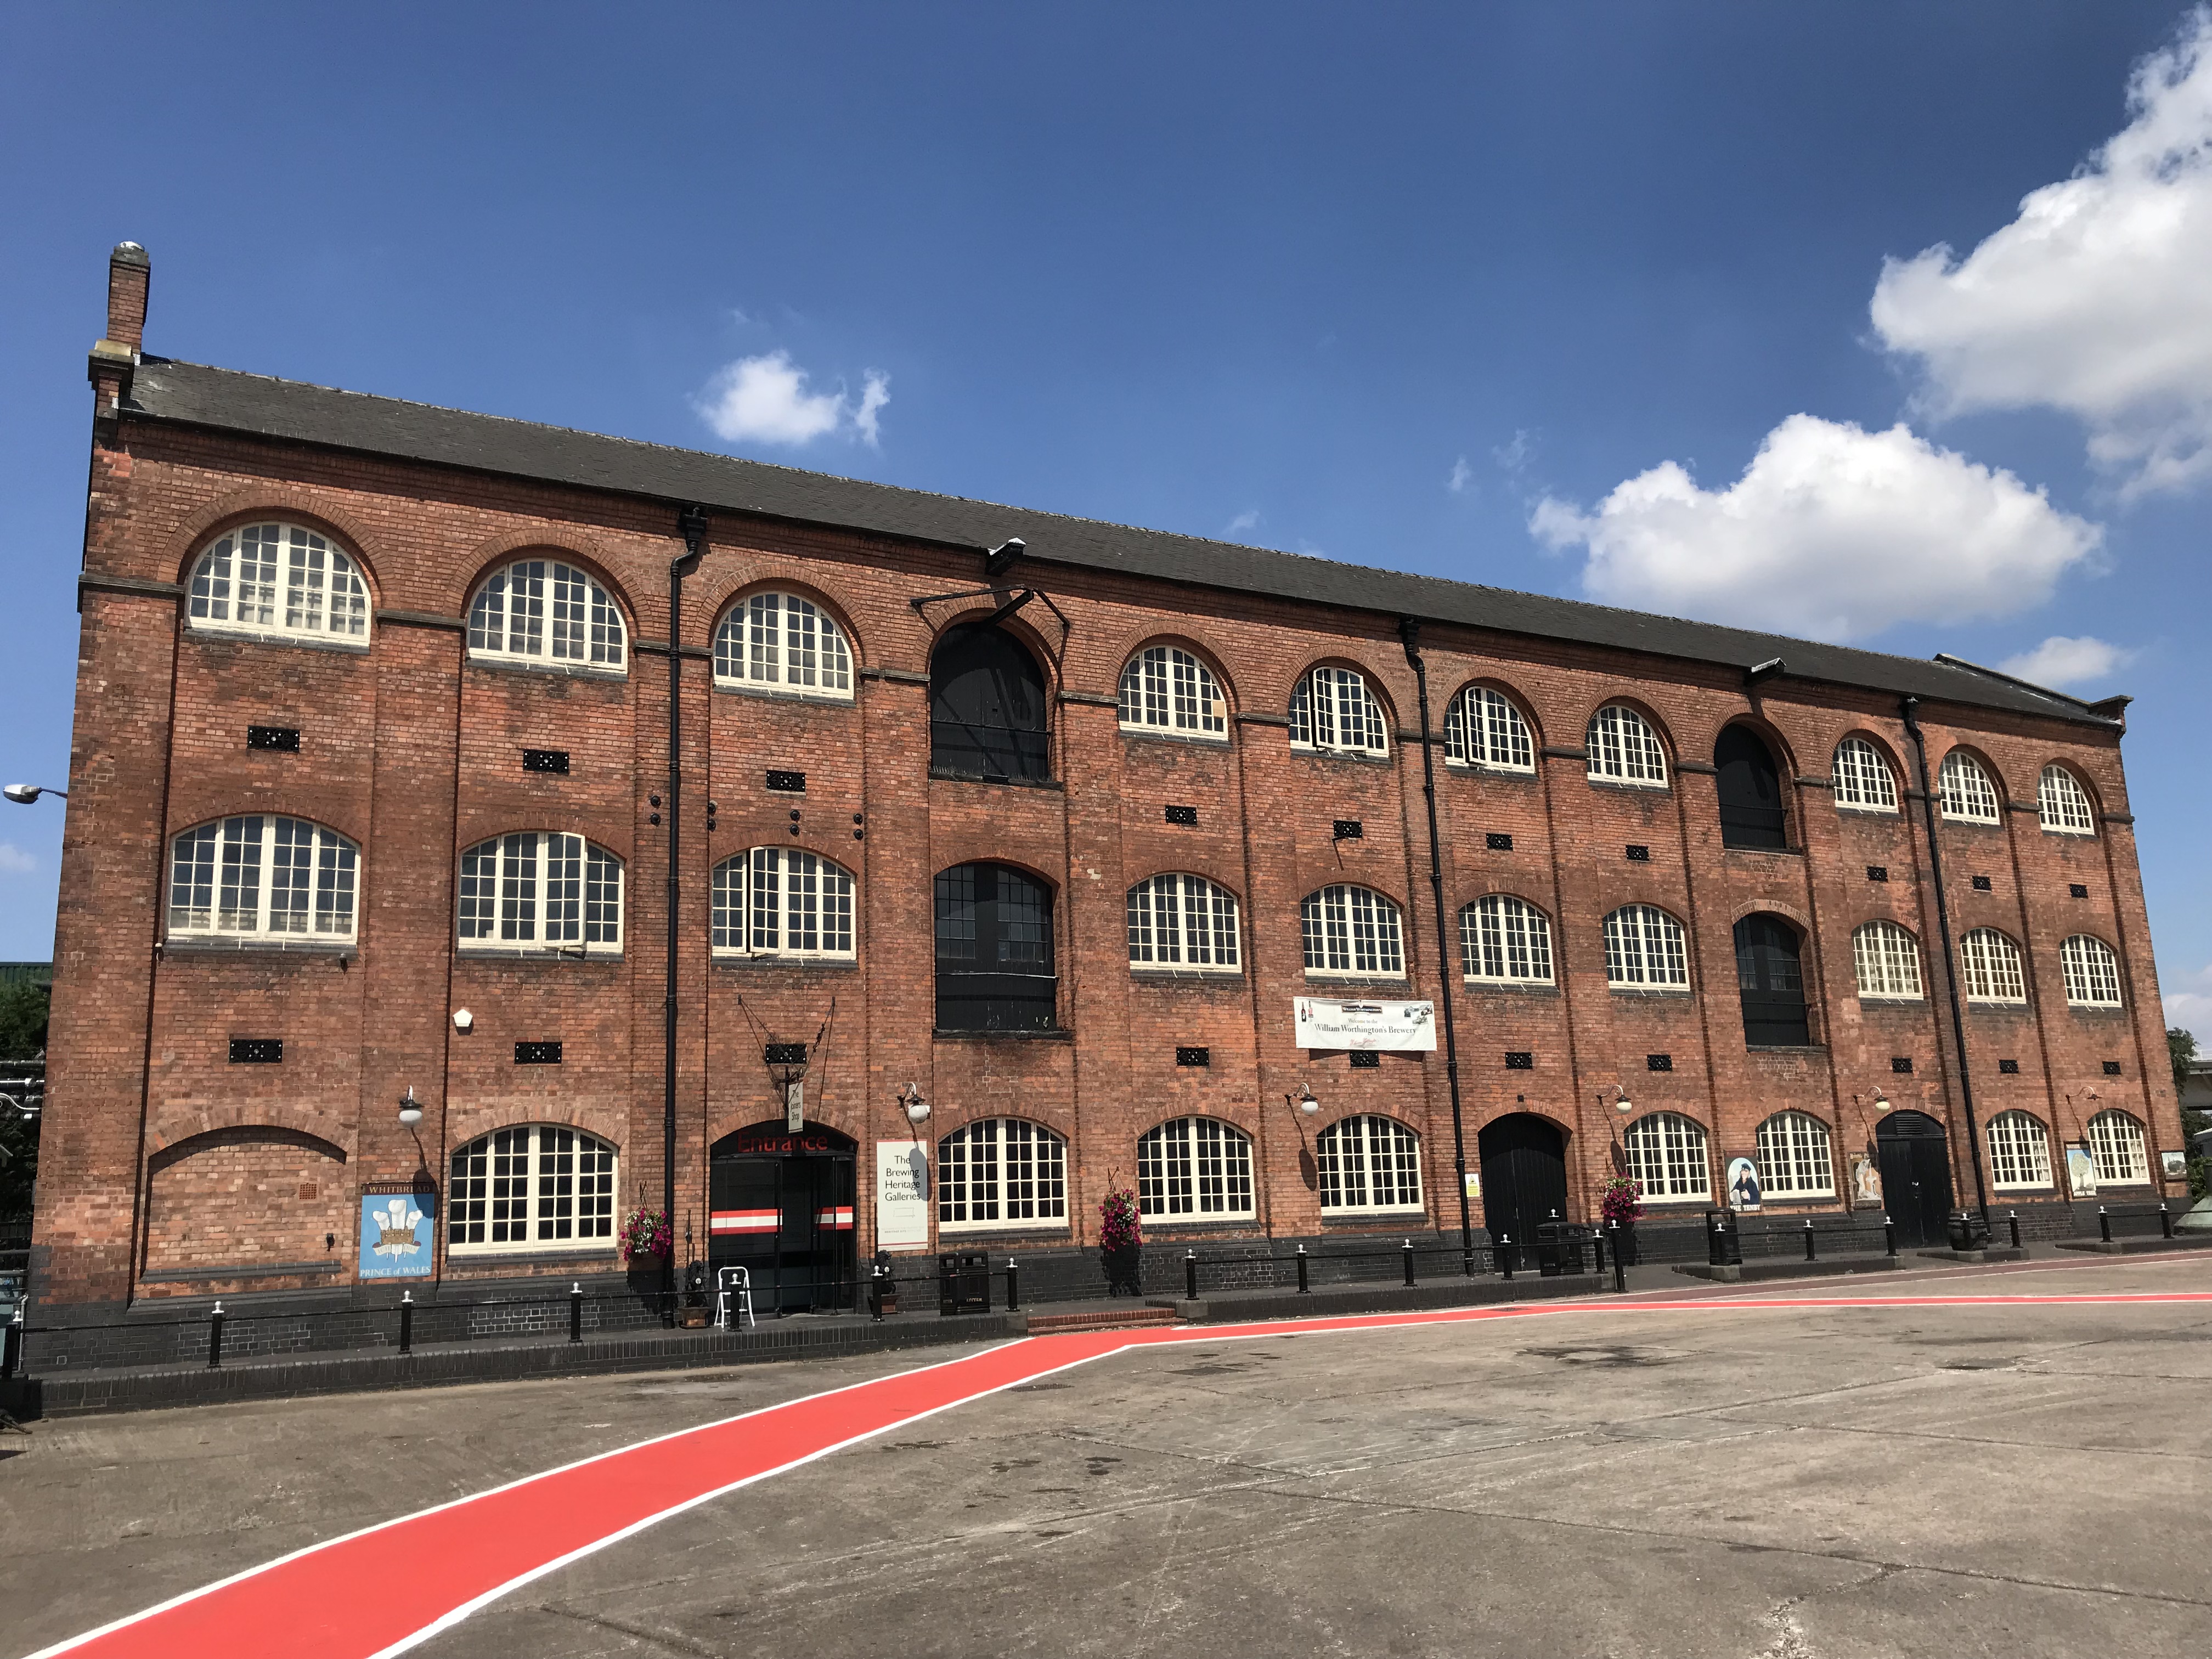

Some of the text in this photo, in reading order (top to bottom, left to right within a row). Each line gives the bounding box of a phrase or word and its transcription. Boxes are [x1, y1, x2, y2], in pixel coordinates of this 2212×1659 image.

[1314, 1023, 1416, 1036] William Worthington's Brewery
[792, 1111, 800, 1122] Shop
[737, 1131, 828, 1152] Entrance
[894, 1155, 911, 1164] The
[886, 1167, 919, 1178] Brewing
[369, 1186, 430, 1194] WHITBREAD
[885, 1180, 920, 1190] Heritage
[885, 1192, 921, 1201] Galleries
[360, 1268, 392, 1277] PRINCE
